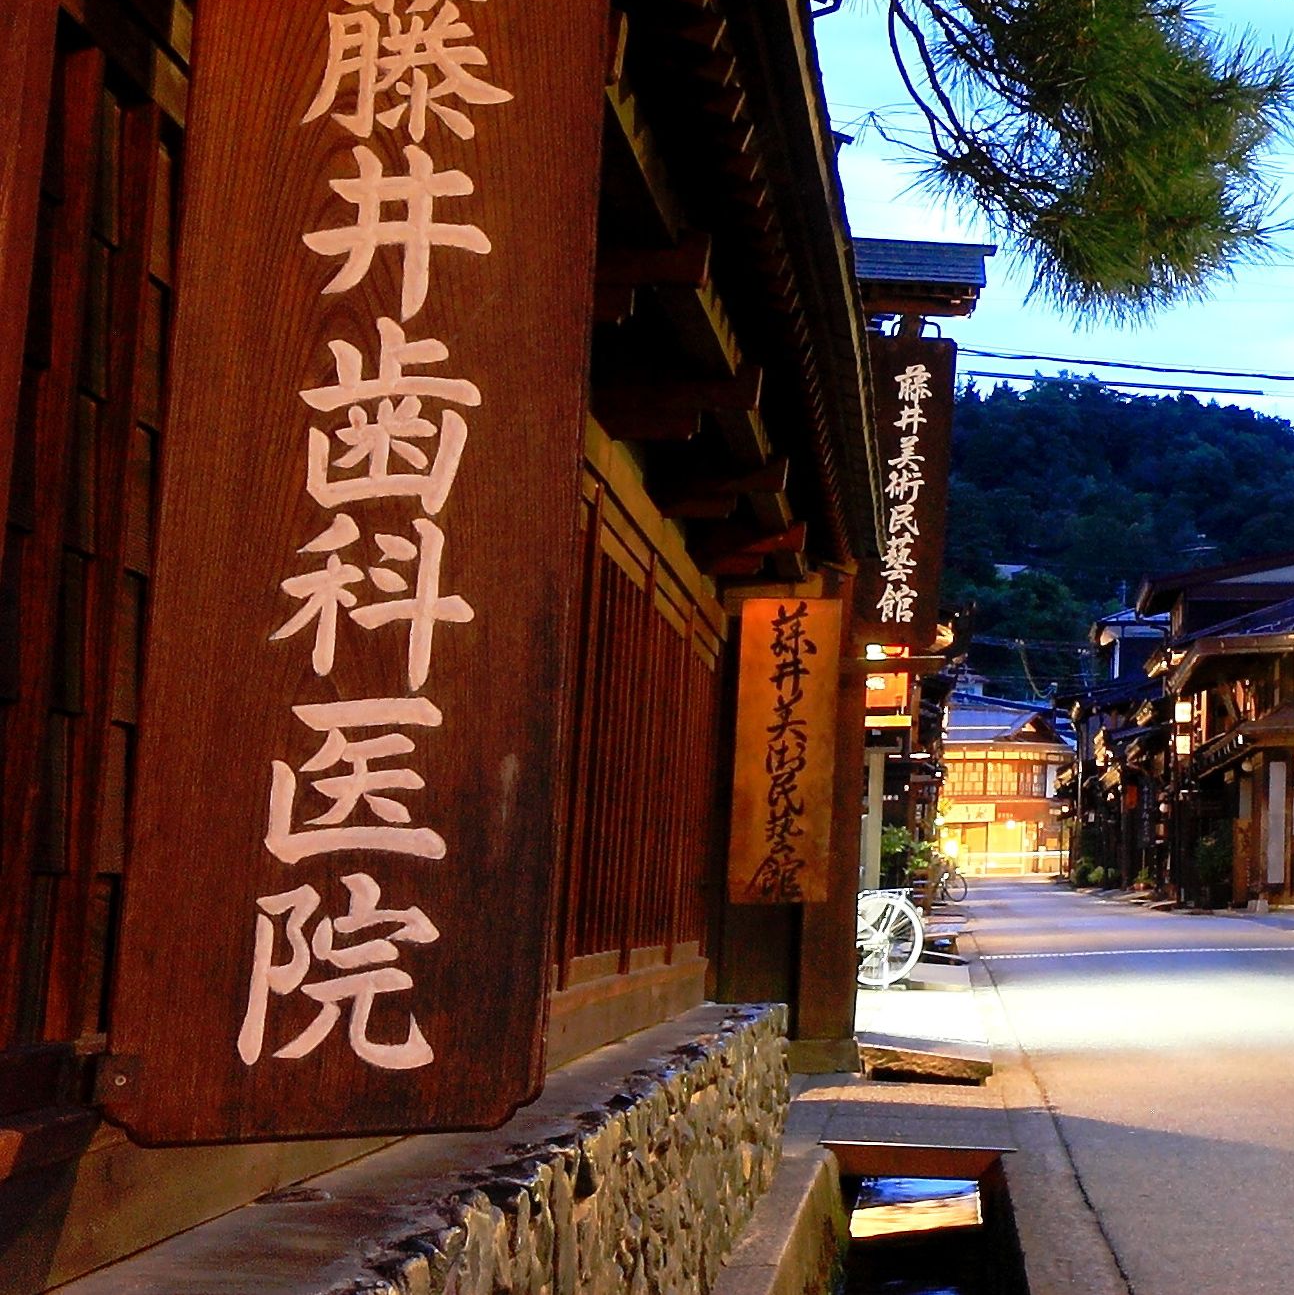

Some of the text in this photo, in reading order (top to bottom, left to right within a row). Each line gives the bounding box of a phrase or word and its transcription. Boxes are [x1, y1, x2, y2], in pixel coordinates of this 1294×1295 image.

[875, 363, 933, 624] 藤井美術民藝館
